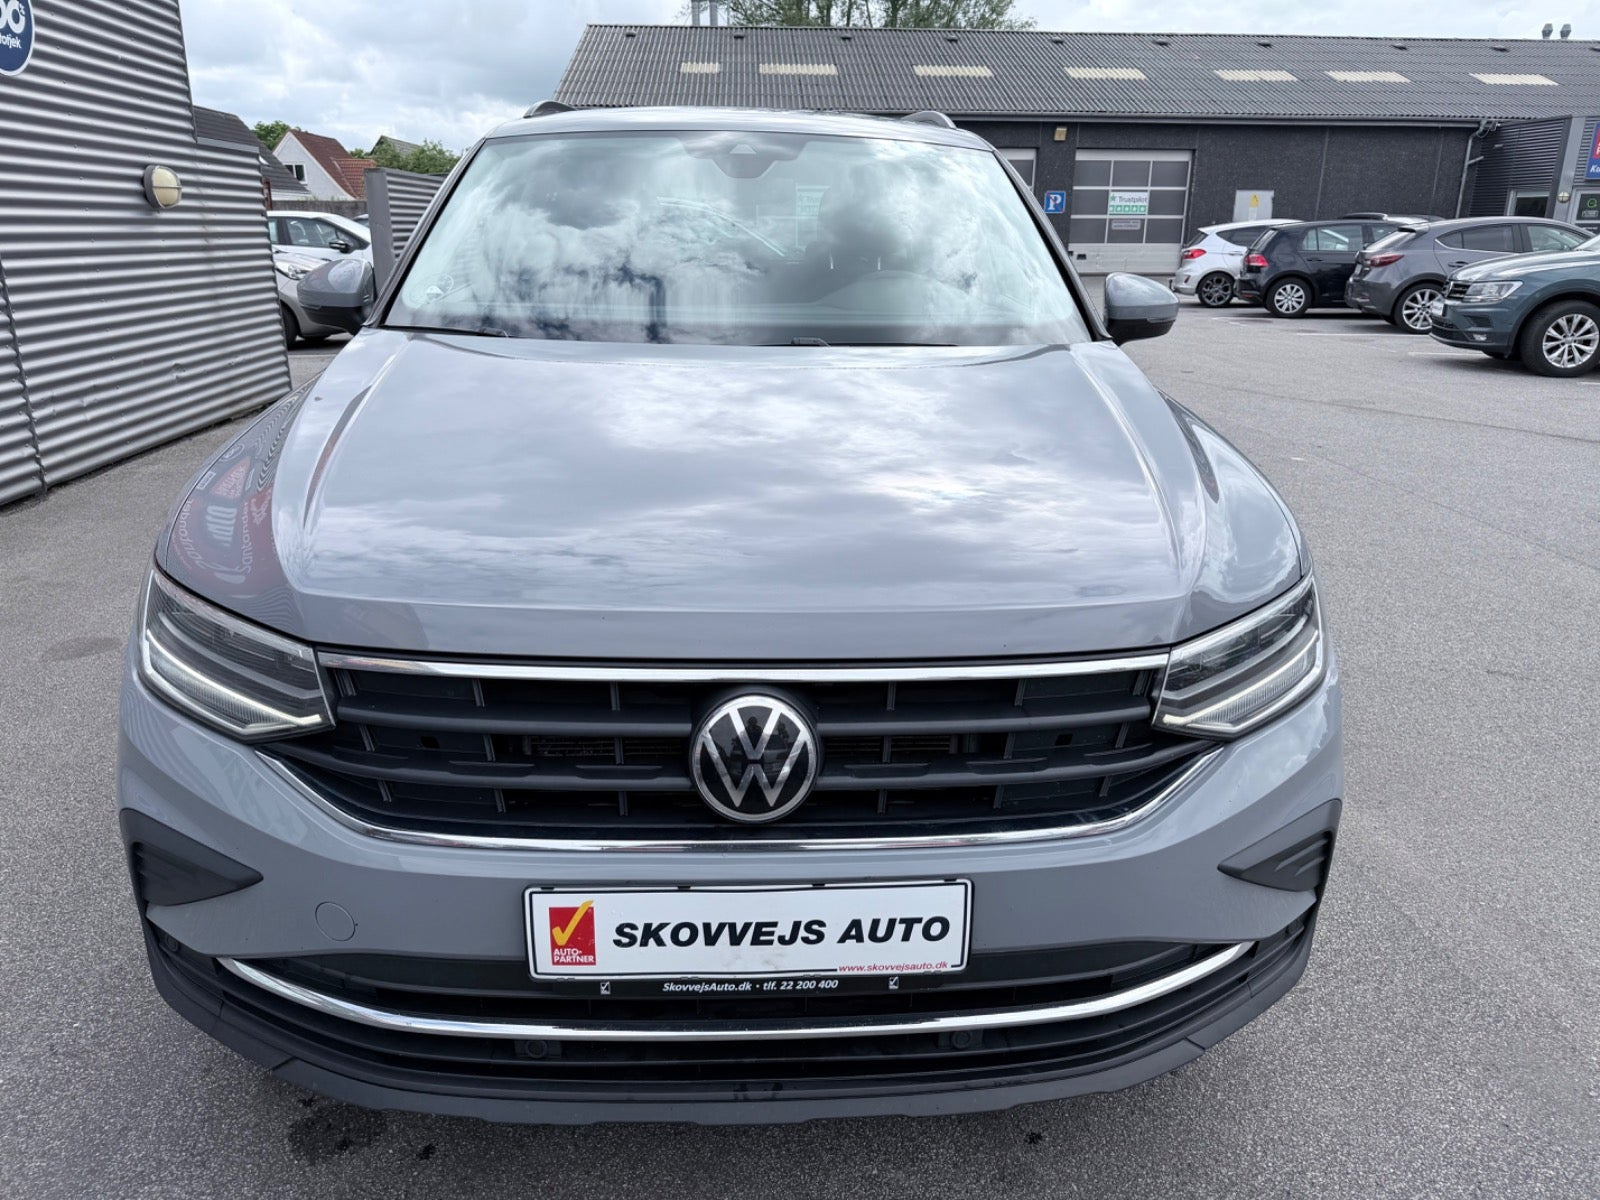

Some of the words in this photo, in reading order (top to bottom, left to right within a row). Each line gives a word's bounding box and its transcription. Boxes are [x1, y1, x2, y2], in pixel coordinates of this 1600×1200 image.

[1048, 194, 1062, 210] P
[1118, 195, 1147, 204] Trustpilot
[612, 919, 827, 949] SKOVVEJS
[837, 916, 950, 944] AUTO
[553, 948, 583, 956] AUTO-
[553, 955, 595, 963] PARTNER
[838, 961, 949, 972] www.skovvejsauto.dk
[662, 981, 753, 993] SkovvejsAuto.dk
[763, 980, 778, 991] tlf.
[780, 980, 794, 990] 22
[795, 980, 817, 989] 200
[818, 979, 839, 988] 400
